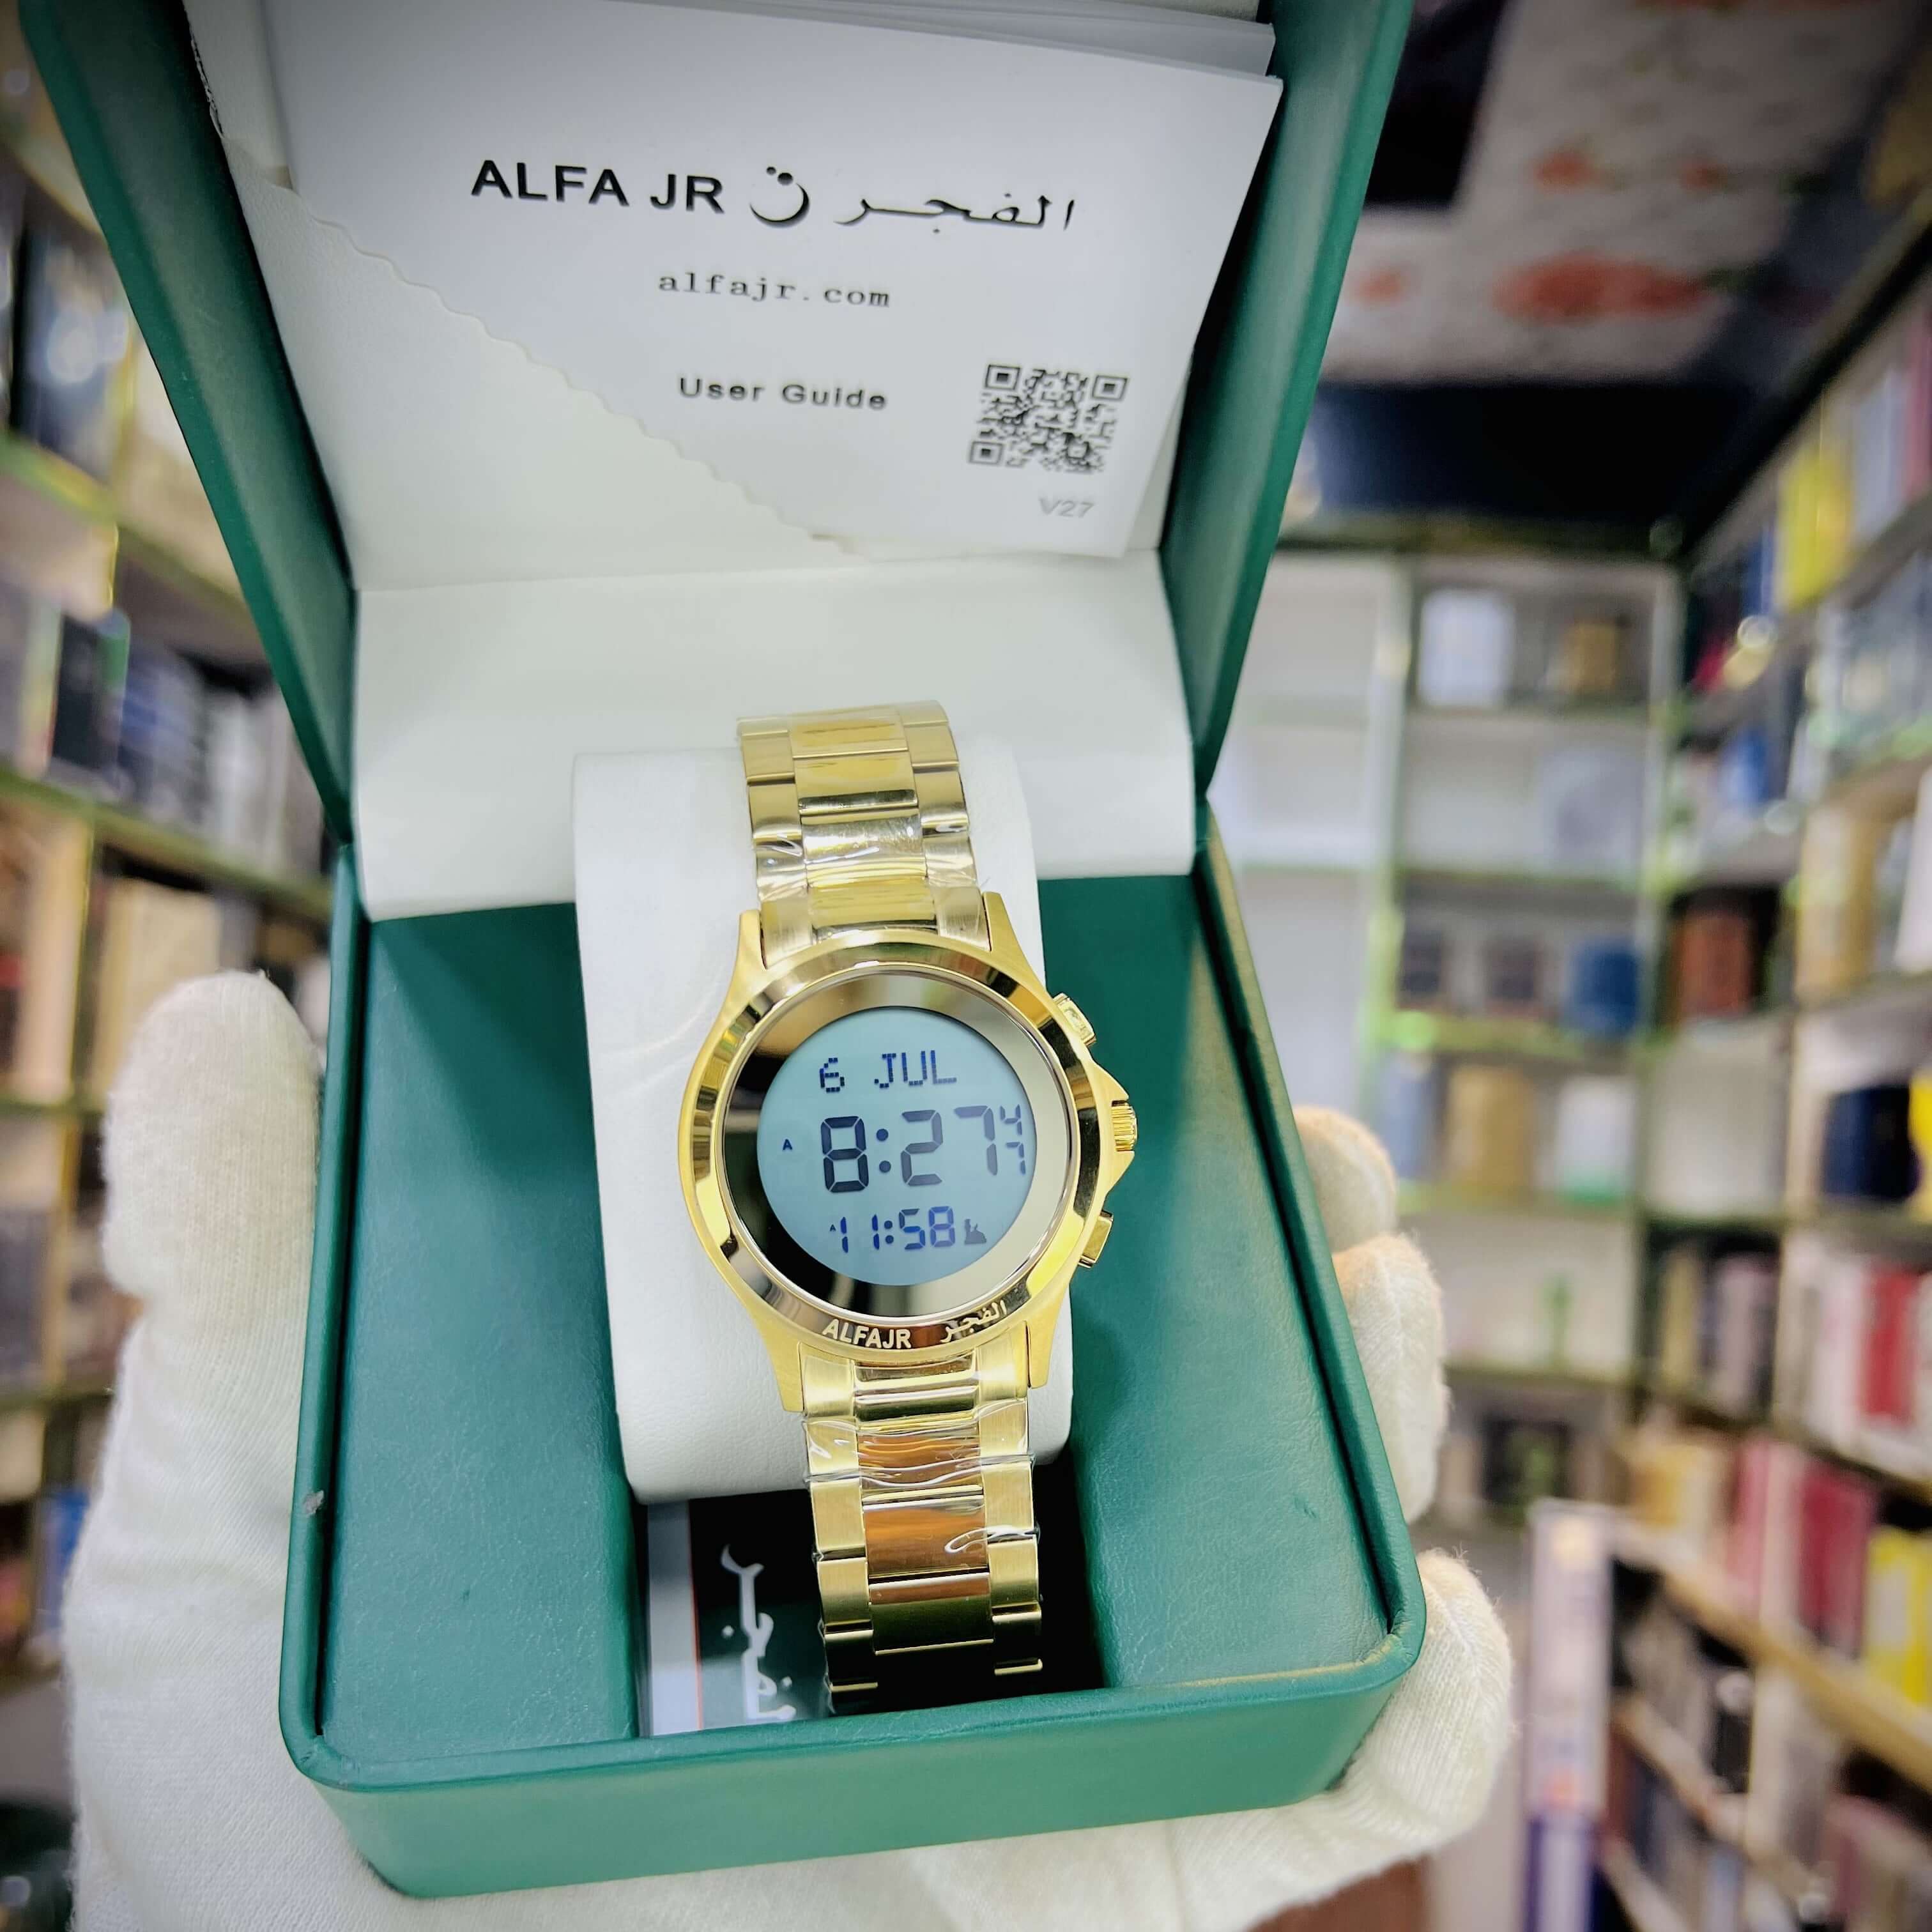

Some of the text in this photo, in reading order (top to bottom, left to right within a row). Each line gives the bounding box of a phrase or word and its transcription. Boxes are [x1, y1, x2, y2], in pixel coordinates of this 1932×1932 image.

[833, 193, 1075, 234] الفجر
[659, 272, 890, 307] alfajr.com
[680, 377, 887, 410] User Guide
[1039, 498, 1095, 518] V27
[819, 1050, 957, 1094] 6 JUL
[782, 1138, 793, 1151] A
[820, 1105, 998, 1194] 8:27
[840, 1206, 956, 1254] 11:58
[822, 1318, 912, 1349] ALFAJR
[940, 1300, 1008, 1343] الفجر
[721, 1544, 797, 1719] لفجر
